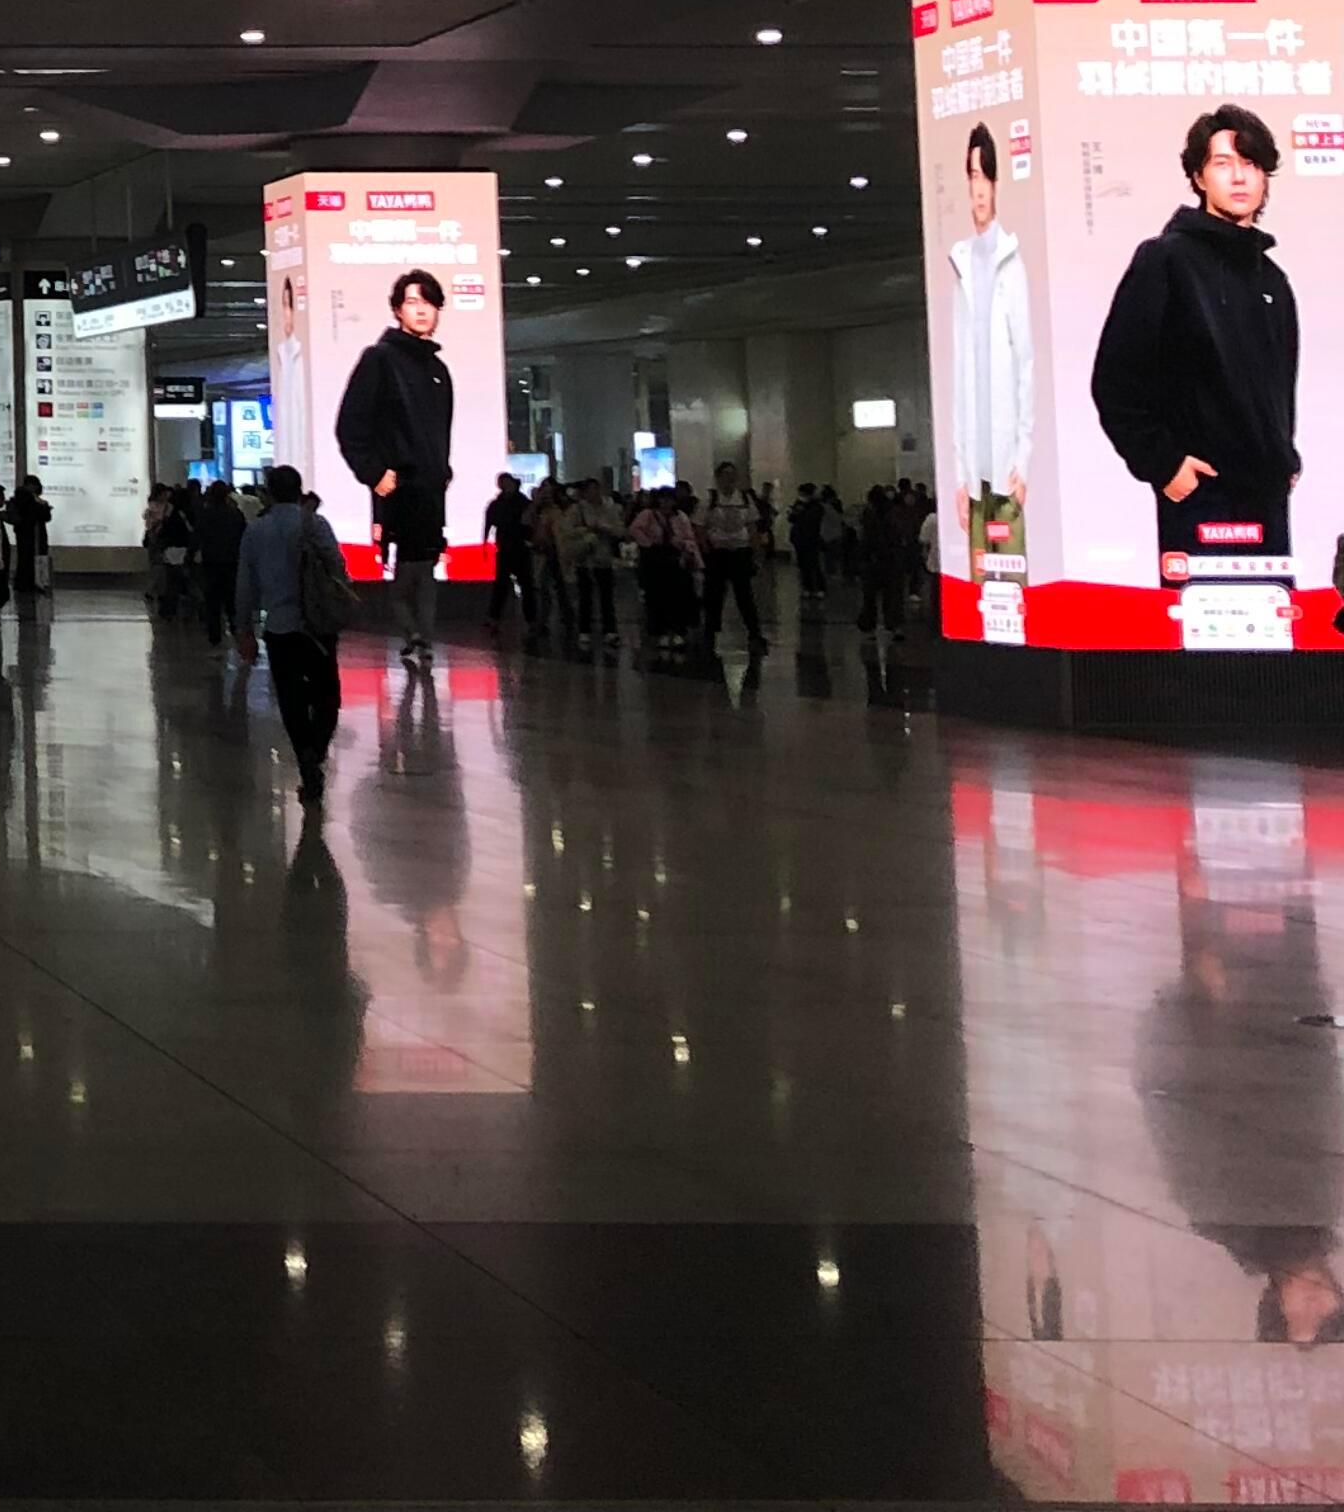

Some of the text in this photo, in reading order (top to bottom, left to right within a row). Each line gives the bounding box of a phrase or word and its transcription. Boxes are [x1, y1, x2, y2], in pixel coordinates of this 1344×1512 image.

[1110, 18, 1306, 56] 中国第一件
